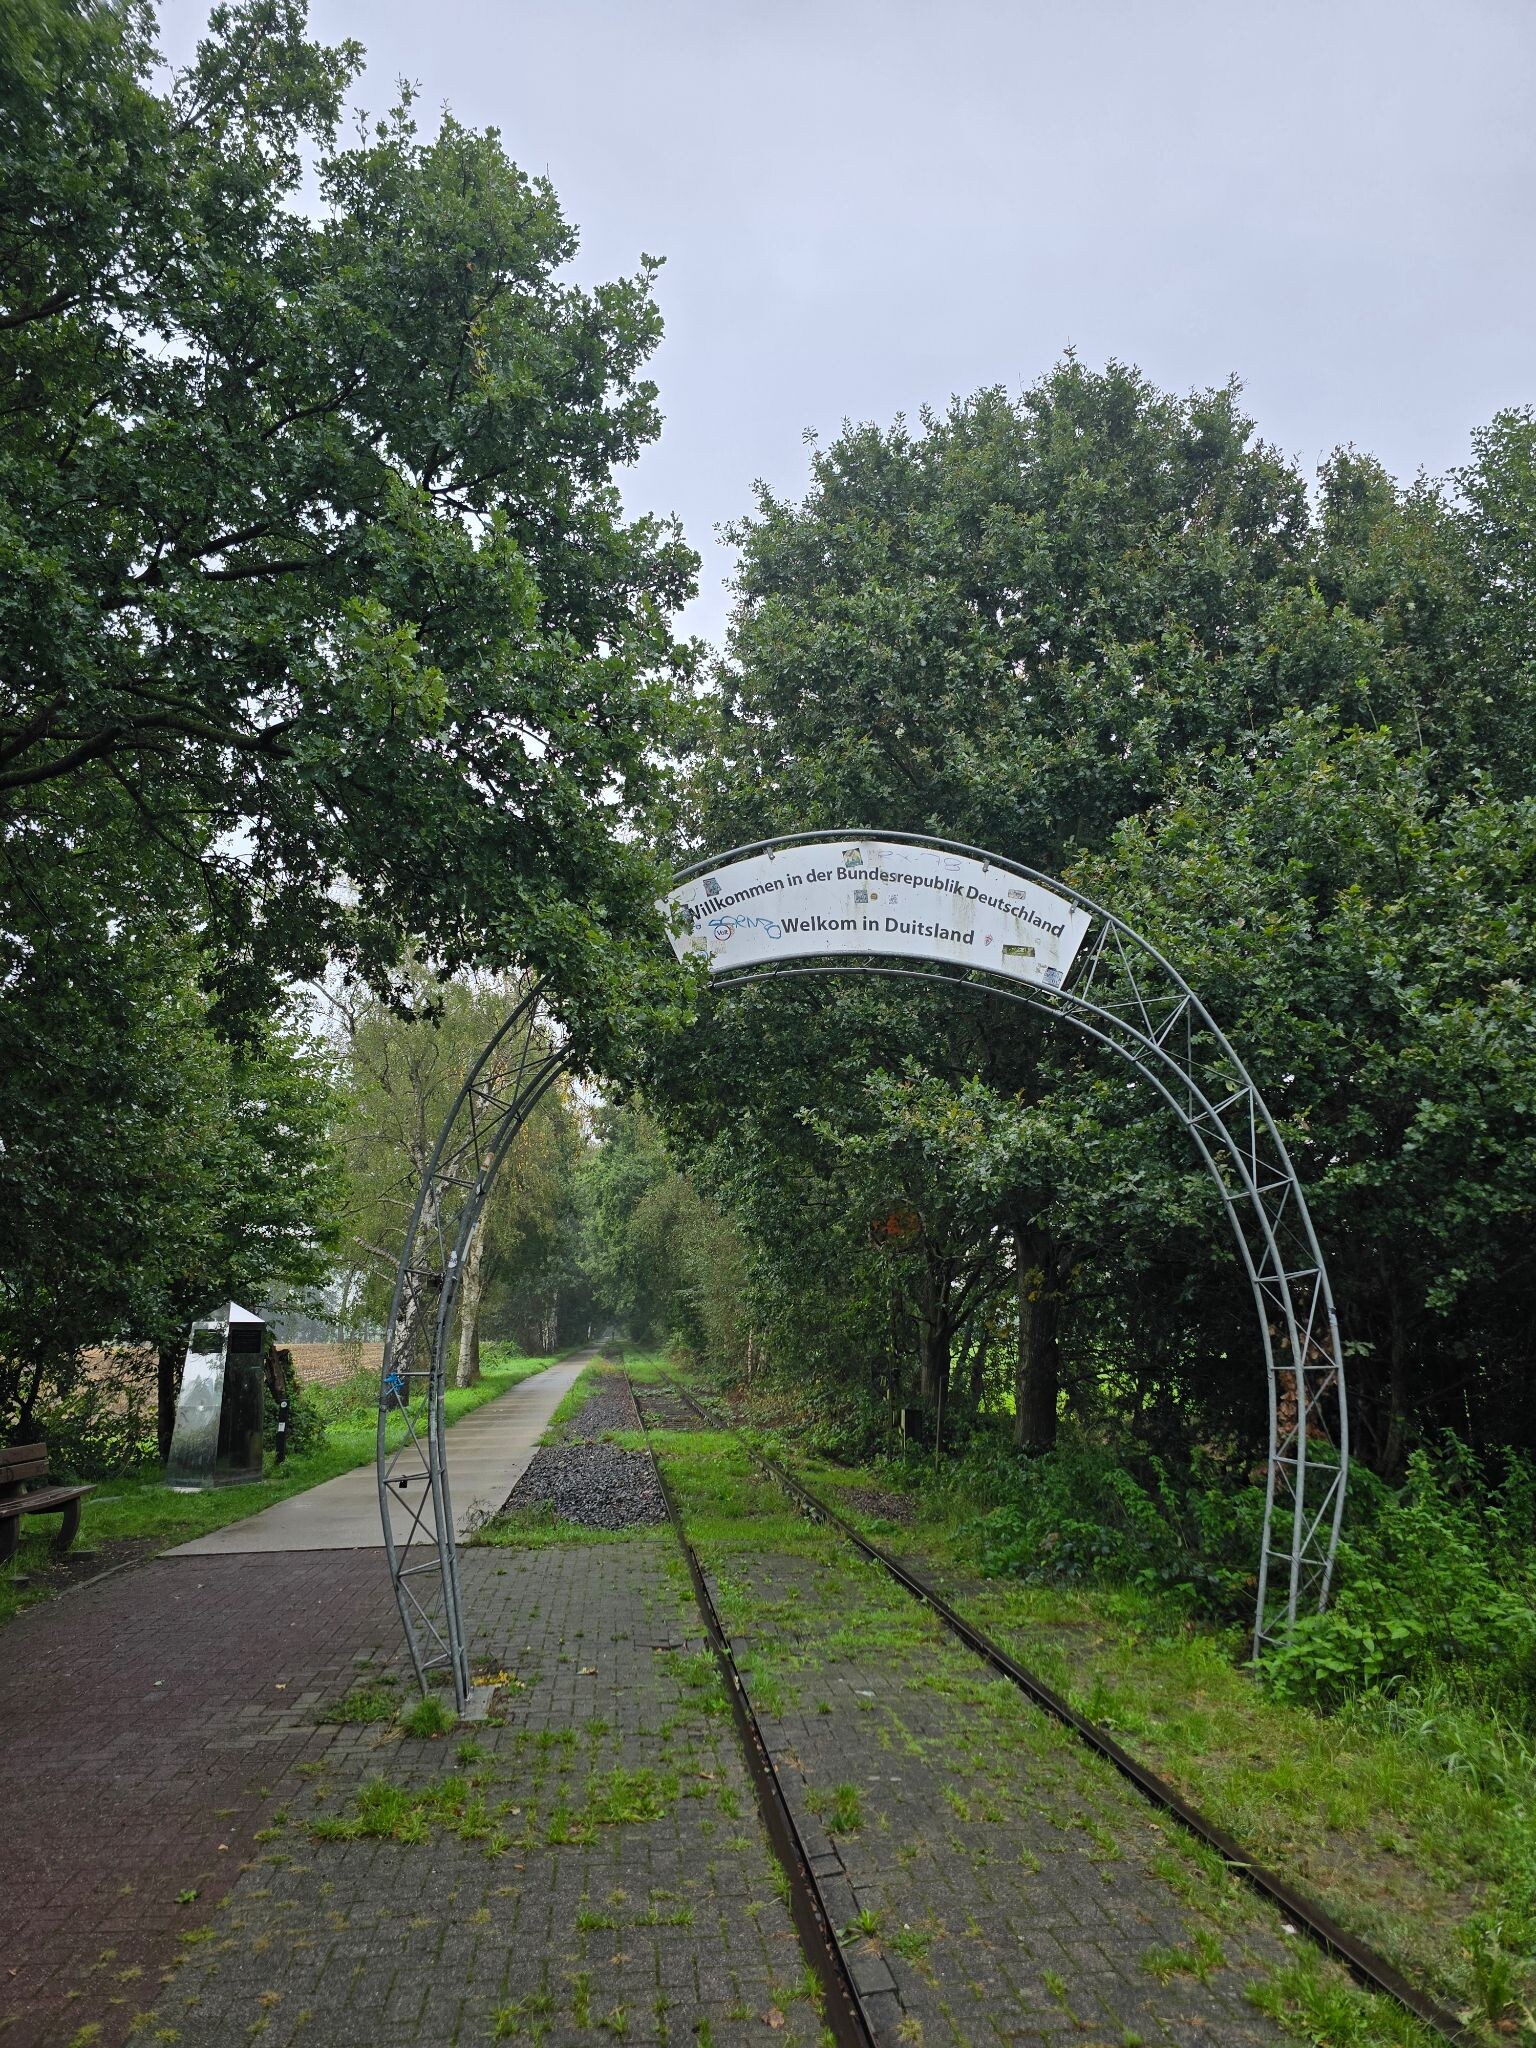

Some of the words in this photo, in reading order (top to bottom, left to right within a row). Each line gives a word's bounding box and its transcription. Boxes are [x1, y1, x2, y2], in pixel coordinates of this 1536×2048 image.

[786, 874, 803, 887] in
[806, 869, 833, 883] der
[837, 867, 965, 896] Bundesrepublik
[966, 885, 1065, 938] Deutschland
[781, 916, 857, 934] Welkom
[863, 916, 879, 931] in
[885, 917, 975, 945] Duitsland
